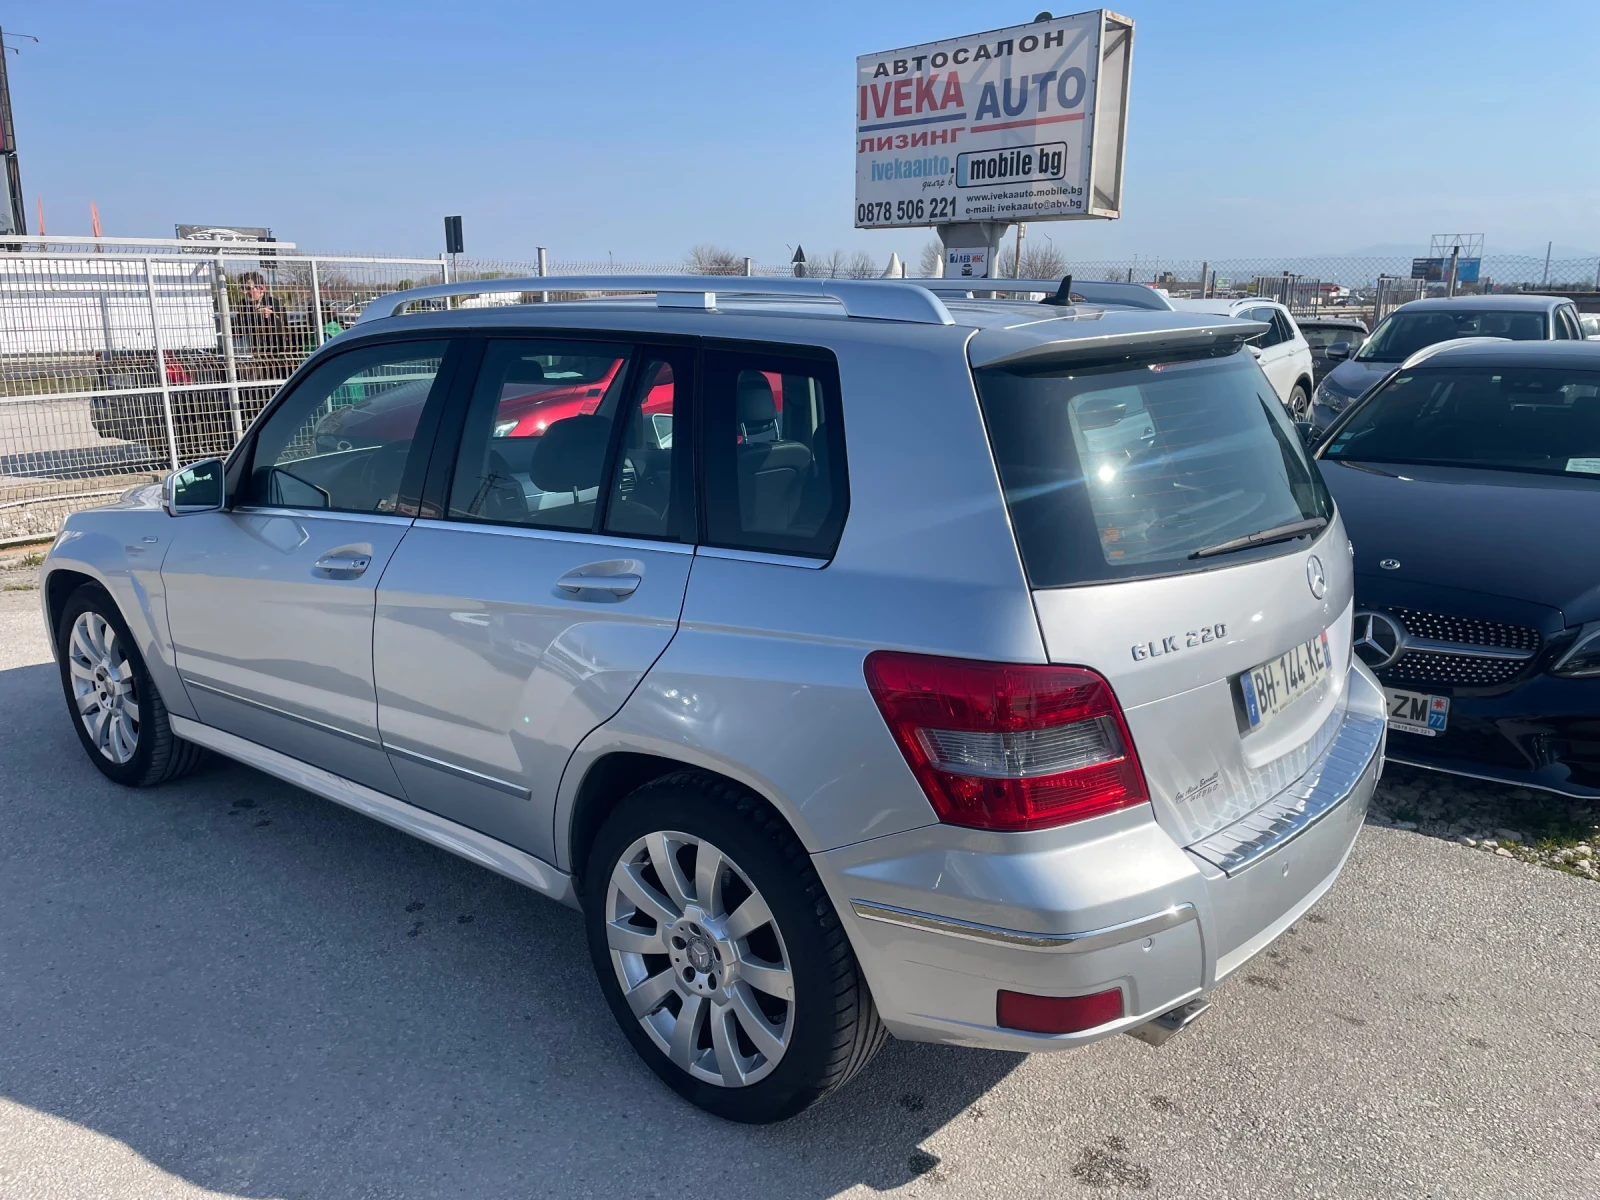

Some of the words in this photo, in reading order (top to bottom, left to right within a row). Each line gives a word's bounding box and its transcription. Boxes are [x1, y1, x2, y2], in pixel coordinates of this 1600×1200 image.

[873, 30, 1064, 78] АВТОСАЛОН
[860, 71, 964, 120] IVEKA
[975, 67, 1086, 120] AUTO
[858, 127, 965, 153] ЛИЗИНГ
[970, 150, 1032, 180] mobile
[1038, 148, 1062, 176] bg
[965, 204, 995, 214] e-mail:
[998, 199, 1082, 212] ivekaauto@abv.bg
[966, 186, 1083, 202] www.ivekaauto.mobile.bg
[858, 201, 892, 222] 0878
[897, 199, 925, 220] 506
[929, 196, 957, 218] 221
[1131, 636, 1180, 662] GLK
[1186, 623, 1228, 648] 220
[1430, 713, 1444, 727] 77
